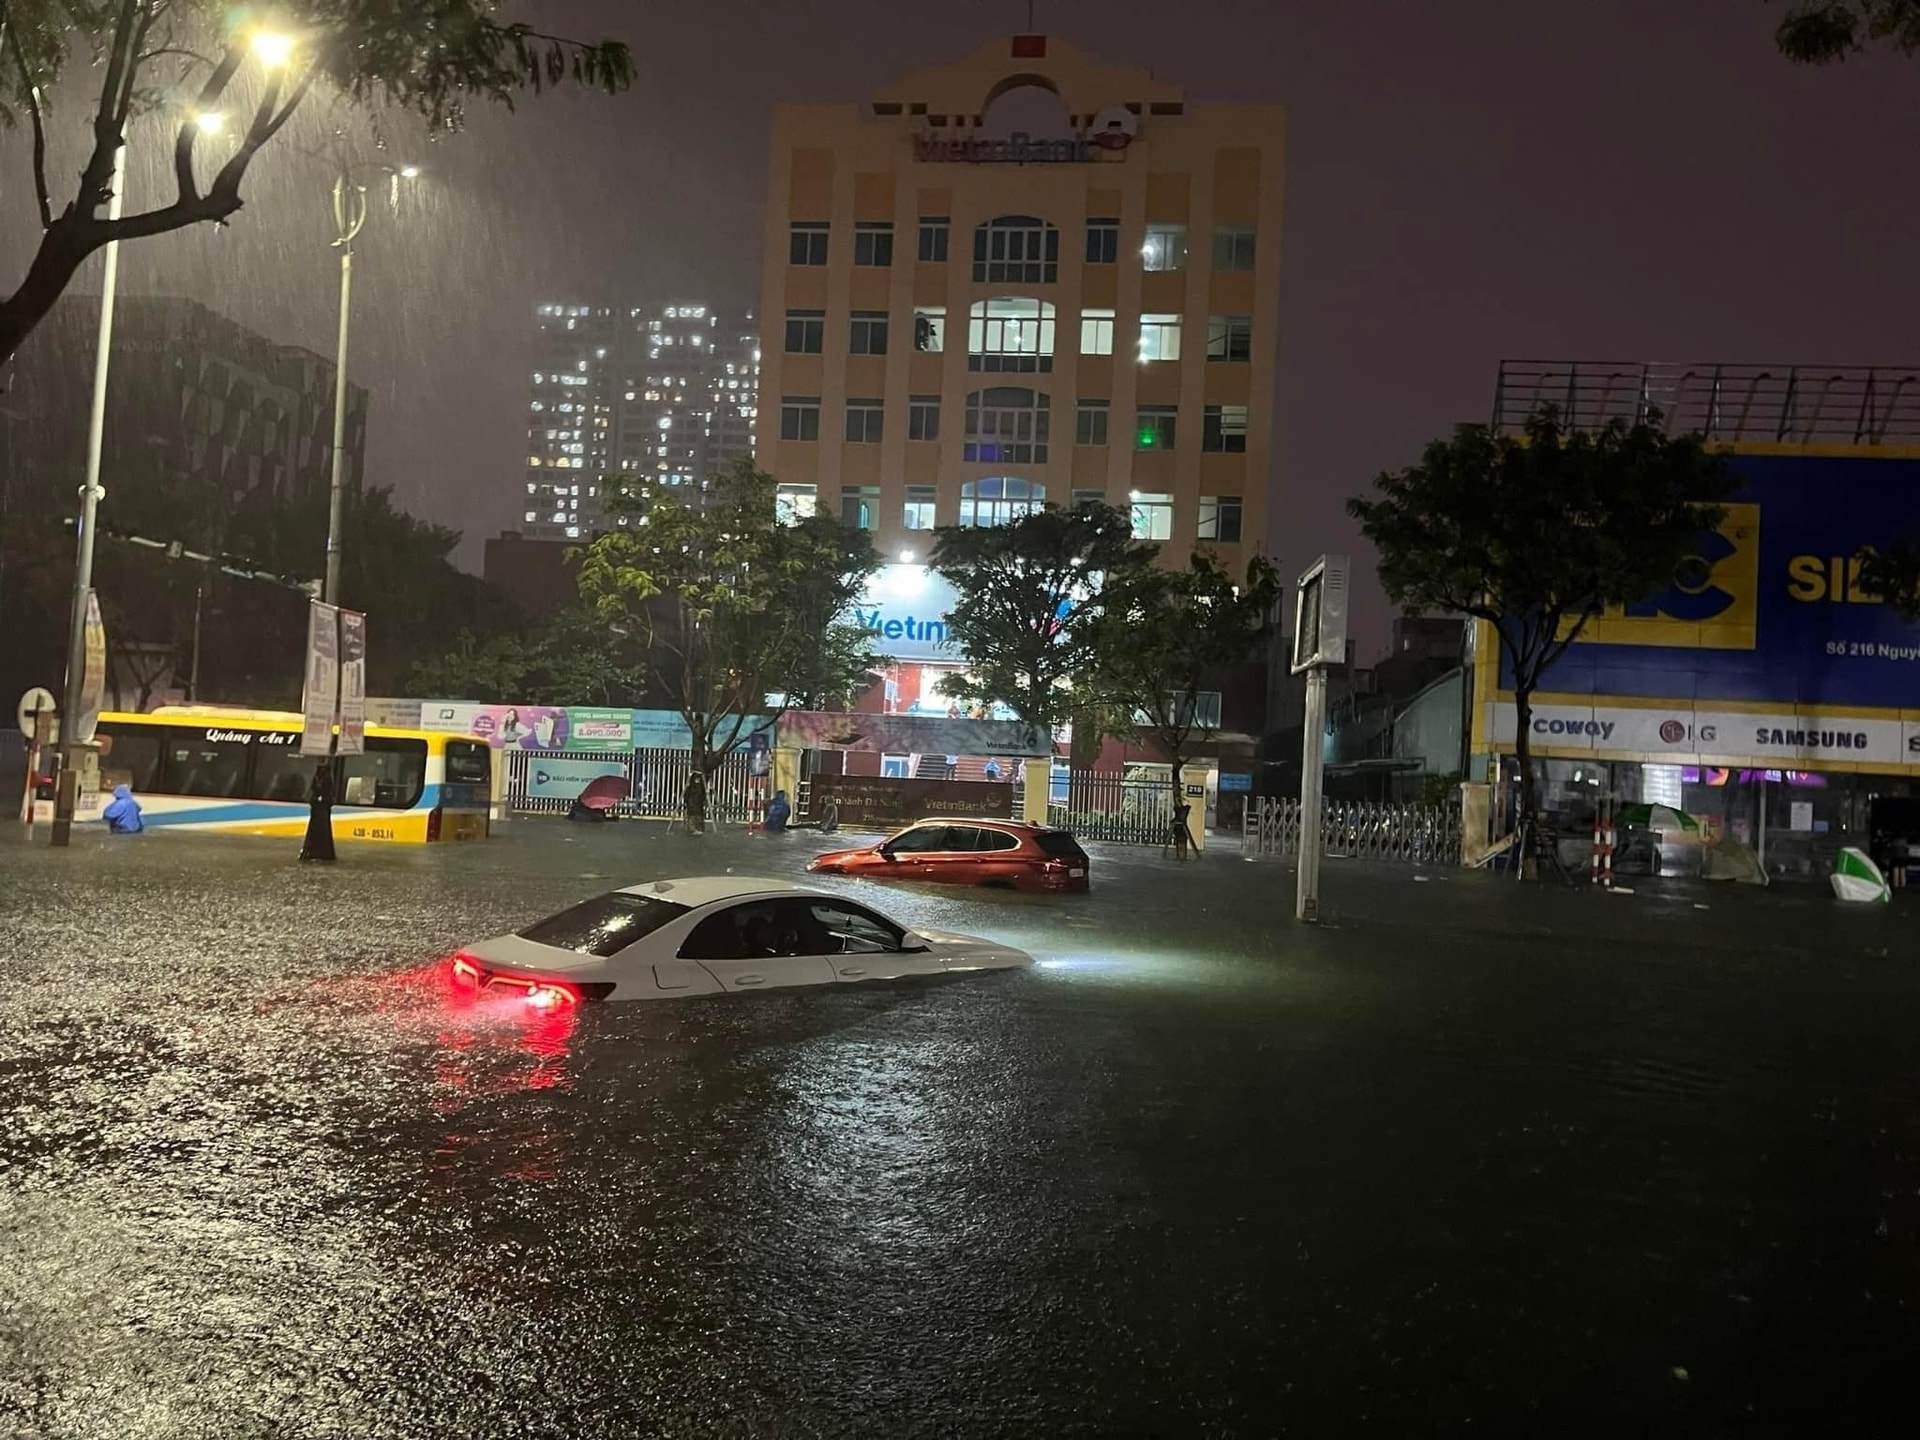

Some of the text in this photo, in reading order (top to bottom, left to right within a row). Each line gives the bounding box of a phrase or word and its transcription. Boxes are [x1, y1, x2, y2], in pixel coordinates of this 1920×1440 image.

[855, 608, 953, 642] Vietin
[1850, 643, 1875, 656] 216
[1878, 644, 1920, 661] Nguy
[1533, 718, 1615, 739] coway
[1757, 727, 1868, 749] SAMSUNG
